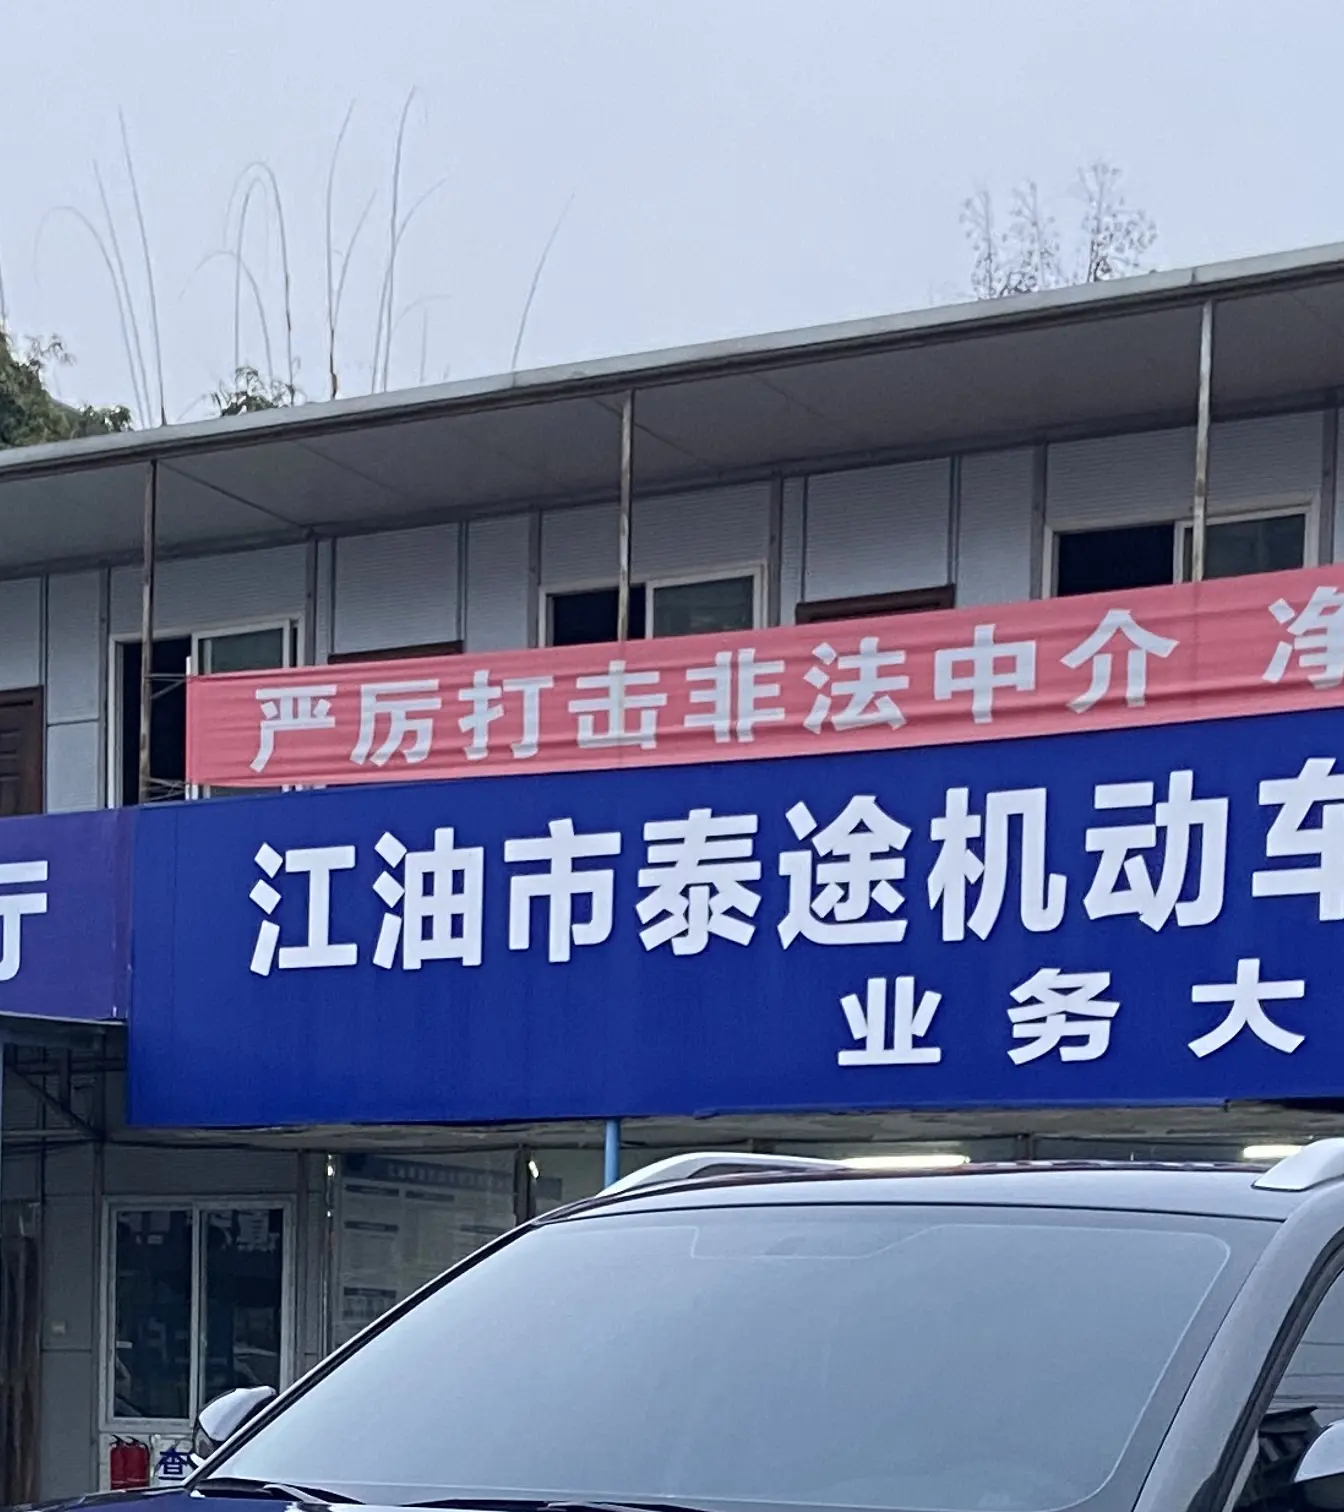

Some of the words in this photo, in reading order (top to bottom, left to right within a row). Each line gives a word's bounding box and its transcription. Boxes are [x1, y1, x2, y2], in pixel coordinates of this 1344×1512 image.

[250, 609, 1180, 773] 严厉打击非法中介
